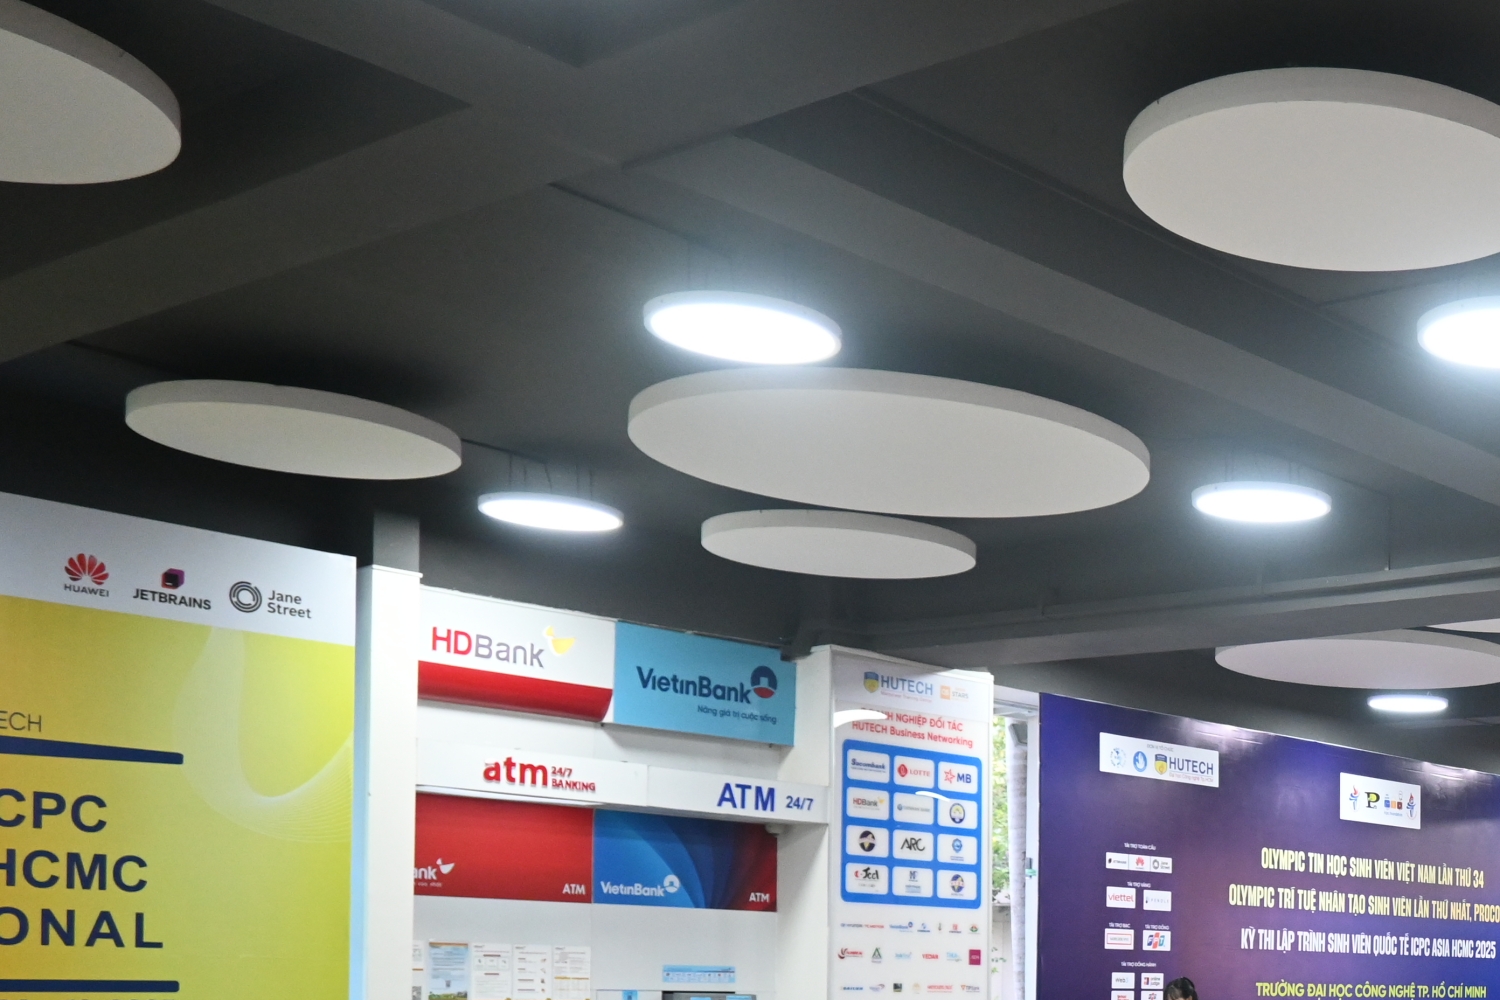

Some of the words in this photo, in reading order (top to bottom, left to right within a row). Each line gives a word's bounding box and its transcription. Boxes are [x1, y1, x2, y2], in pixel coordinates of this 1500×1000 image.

[64, 583, 109, 597] HUAWEI
[133, 588, 212, 610] JETBRAINS
[268, 589, 302, 605] Jane
[267, 602, 312, 619] Street
[431, 626, 544, 668] HDBank
[881, 675, 933, 696] HUTECH
[896, 712, 927, 728] NGHIỆP
[930, 716, 945, 728] ĐỐI
[947, 720, 963, 732] TÁC
[852, 721, 887, 734] HUTECH
[890, 726, 925, 740] Business
[927, 732, 973, 749] Networking
[483, 757, 548, 786] atm
[551, 766, 572, 778] 24/7
[851, 758, 886, 770] Sacombank
[909, 768, 931, 777] LOTTE
[1169, 757, 1214, 775] HUTECH
[551, 777, 596, 792] BANKING
[956, 772, 971, 783] MB
[717, 782, 775, 812] ATM
[785, 795, 814, 811] 24/7
[1261, 847, 1305, 872] OLYMPIC
[1308, 852, 1324, 874] TIN
[1326, 853, 1347, 878] HỌC
[1349, 856, 1372, 878] SINH
[1374, 858, 1395, 881] VIÊN
[1397, 861, 1415, 884] VIỆT
[1417, 863, 1436, 884] NAM
[1437, 862, 1453, 886] LẦN
[1455, 867, 1471, 888] THỨ
[1472, 869, 1484, 889] 34
[562, 883, 586, 895] ATM
[748, 892, 770, 903] ATM
[1108, 894, 1134, 902] viettel
[1229, 883, 1275, 908] OLYMPIC
[1277, 886, 1296, 910] TRÍ
[1297, 888, 1316, 913] TUỆ
[1318, 890, 1345, 913] NHÂN
[1348, 893, 1366, 916] TẠO
[1368, 895, 1390, 916] SINH
[1392, 895, 1412, 918] VIÊN
[1413, 895, 1430, 919] LẦN
[1432, 899, 1448, 920] THỨ
[0, 907, 163, 948] ONAL
[1240, 925, 1256, 950] KỲ
[1258, 929, 1275, 951] THI
[1276, 927, 1296, 954] LẬP
[1297, 929, 1326, 953] TRÌNH
[1327, 932, 1350, 954] SINH
[1351, 932, 1371, 955] VIÊN
[1373, 931, 1397, 957] QUỐC
[1399, 932, 1410, 956] TẾ
[1410, 937, 1430, 957] ICPC
[1431, 938, 1450, 958] ASIA
[1451, 939, 1474, 959] HCMC
[1475, 941, 1496, 959] 2025
[1255, 979, 1304, 998] TRƯỜNG
[1306, 983, 1326, 1000] ĐẠI
[1329, 983, 1353, 1000] HỌC
[1354, 981, 1387, 998] CÔNG
[1388, 982, 1415, 1000] NGHỆ
[1417, 985, 1430, 998] TP.
[1431, 981, 1446, 998] HỒ
[1447, 983, 1463, 998] CHÍ
[1464, 985, 1487, 999] MINH
